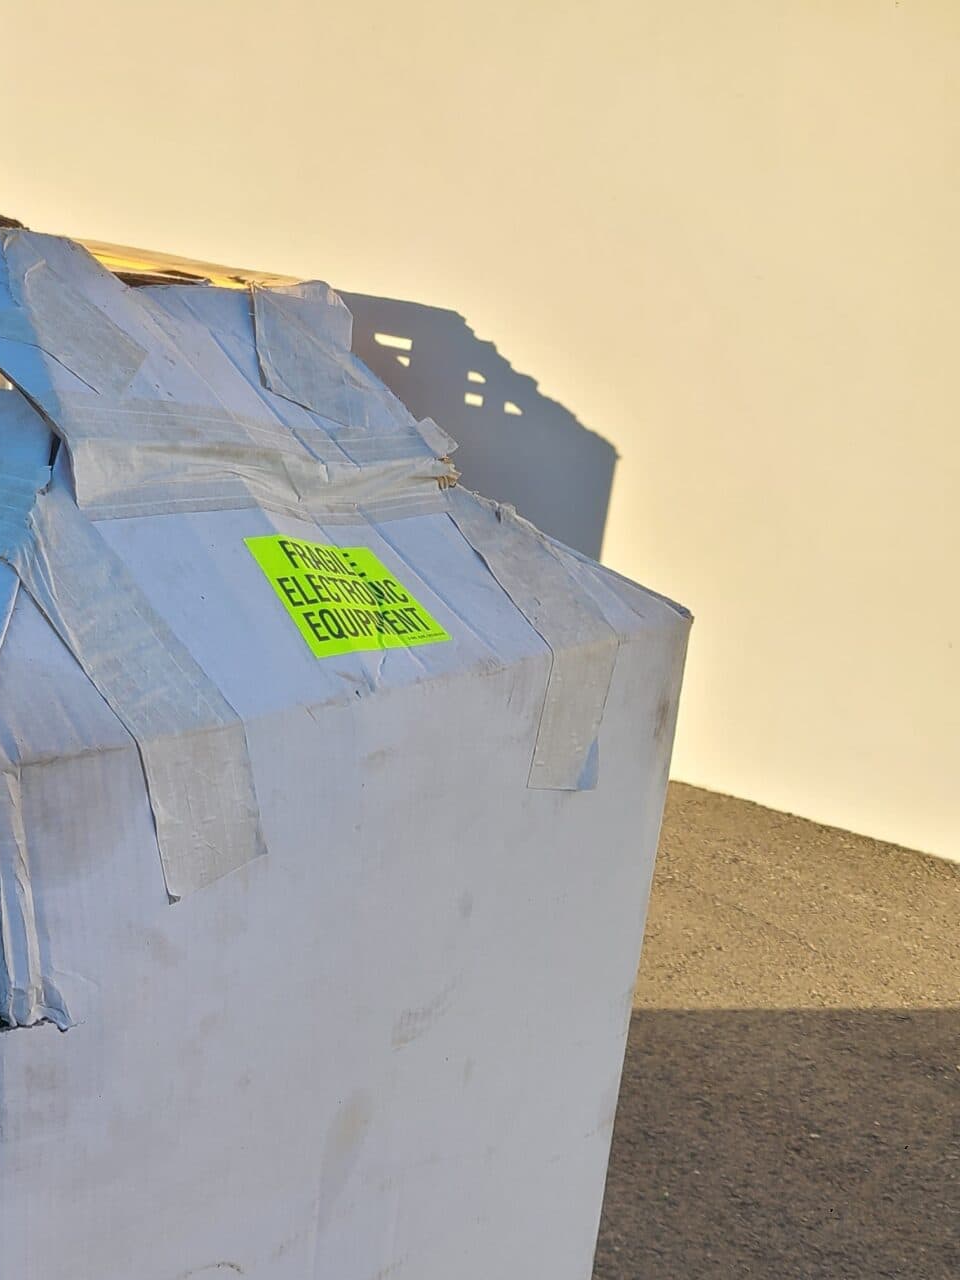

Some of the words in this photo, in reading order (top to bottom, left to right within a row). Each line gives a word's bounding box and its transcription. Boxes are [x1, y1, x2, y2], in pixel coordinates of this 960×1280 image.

[278, 540, 367, 578] FRAGILE
[276, 573, 409, 607] ELECTRONIC
[302, 607, 430, 642] EQUIPMENT
